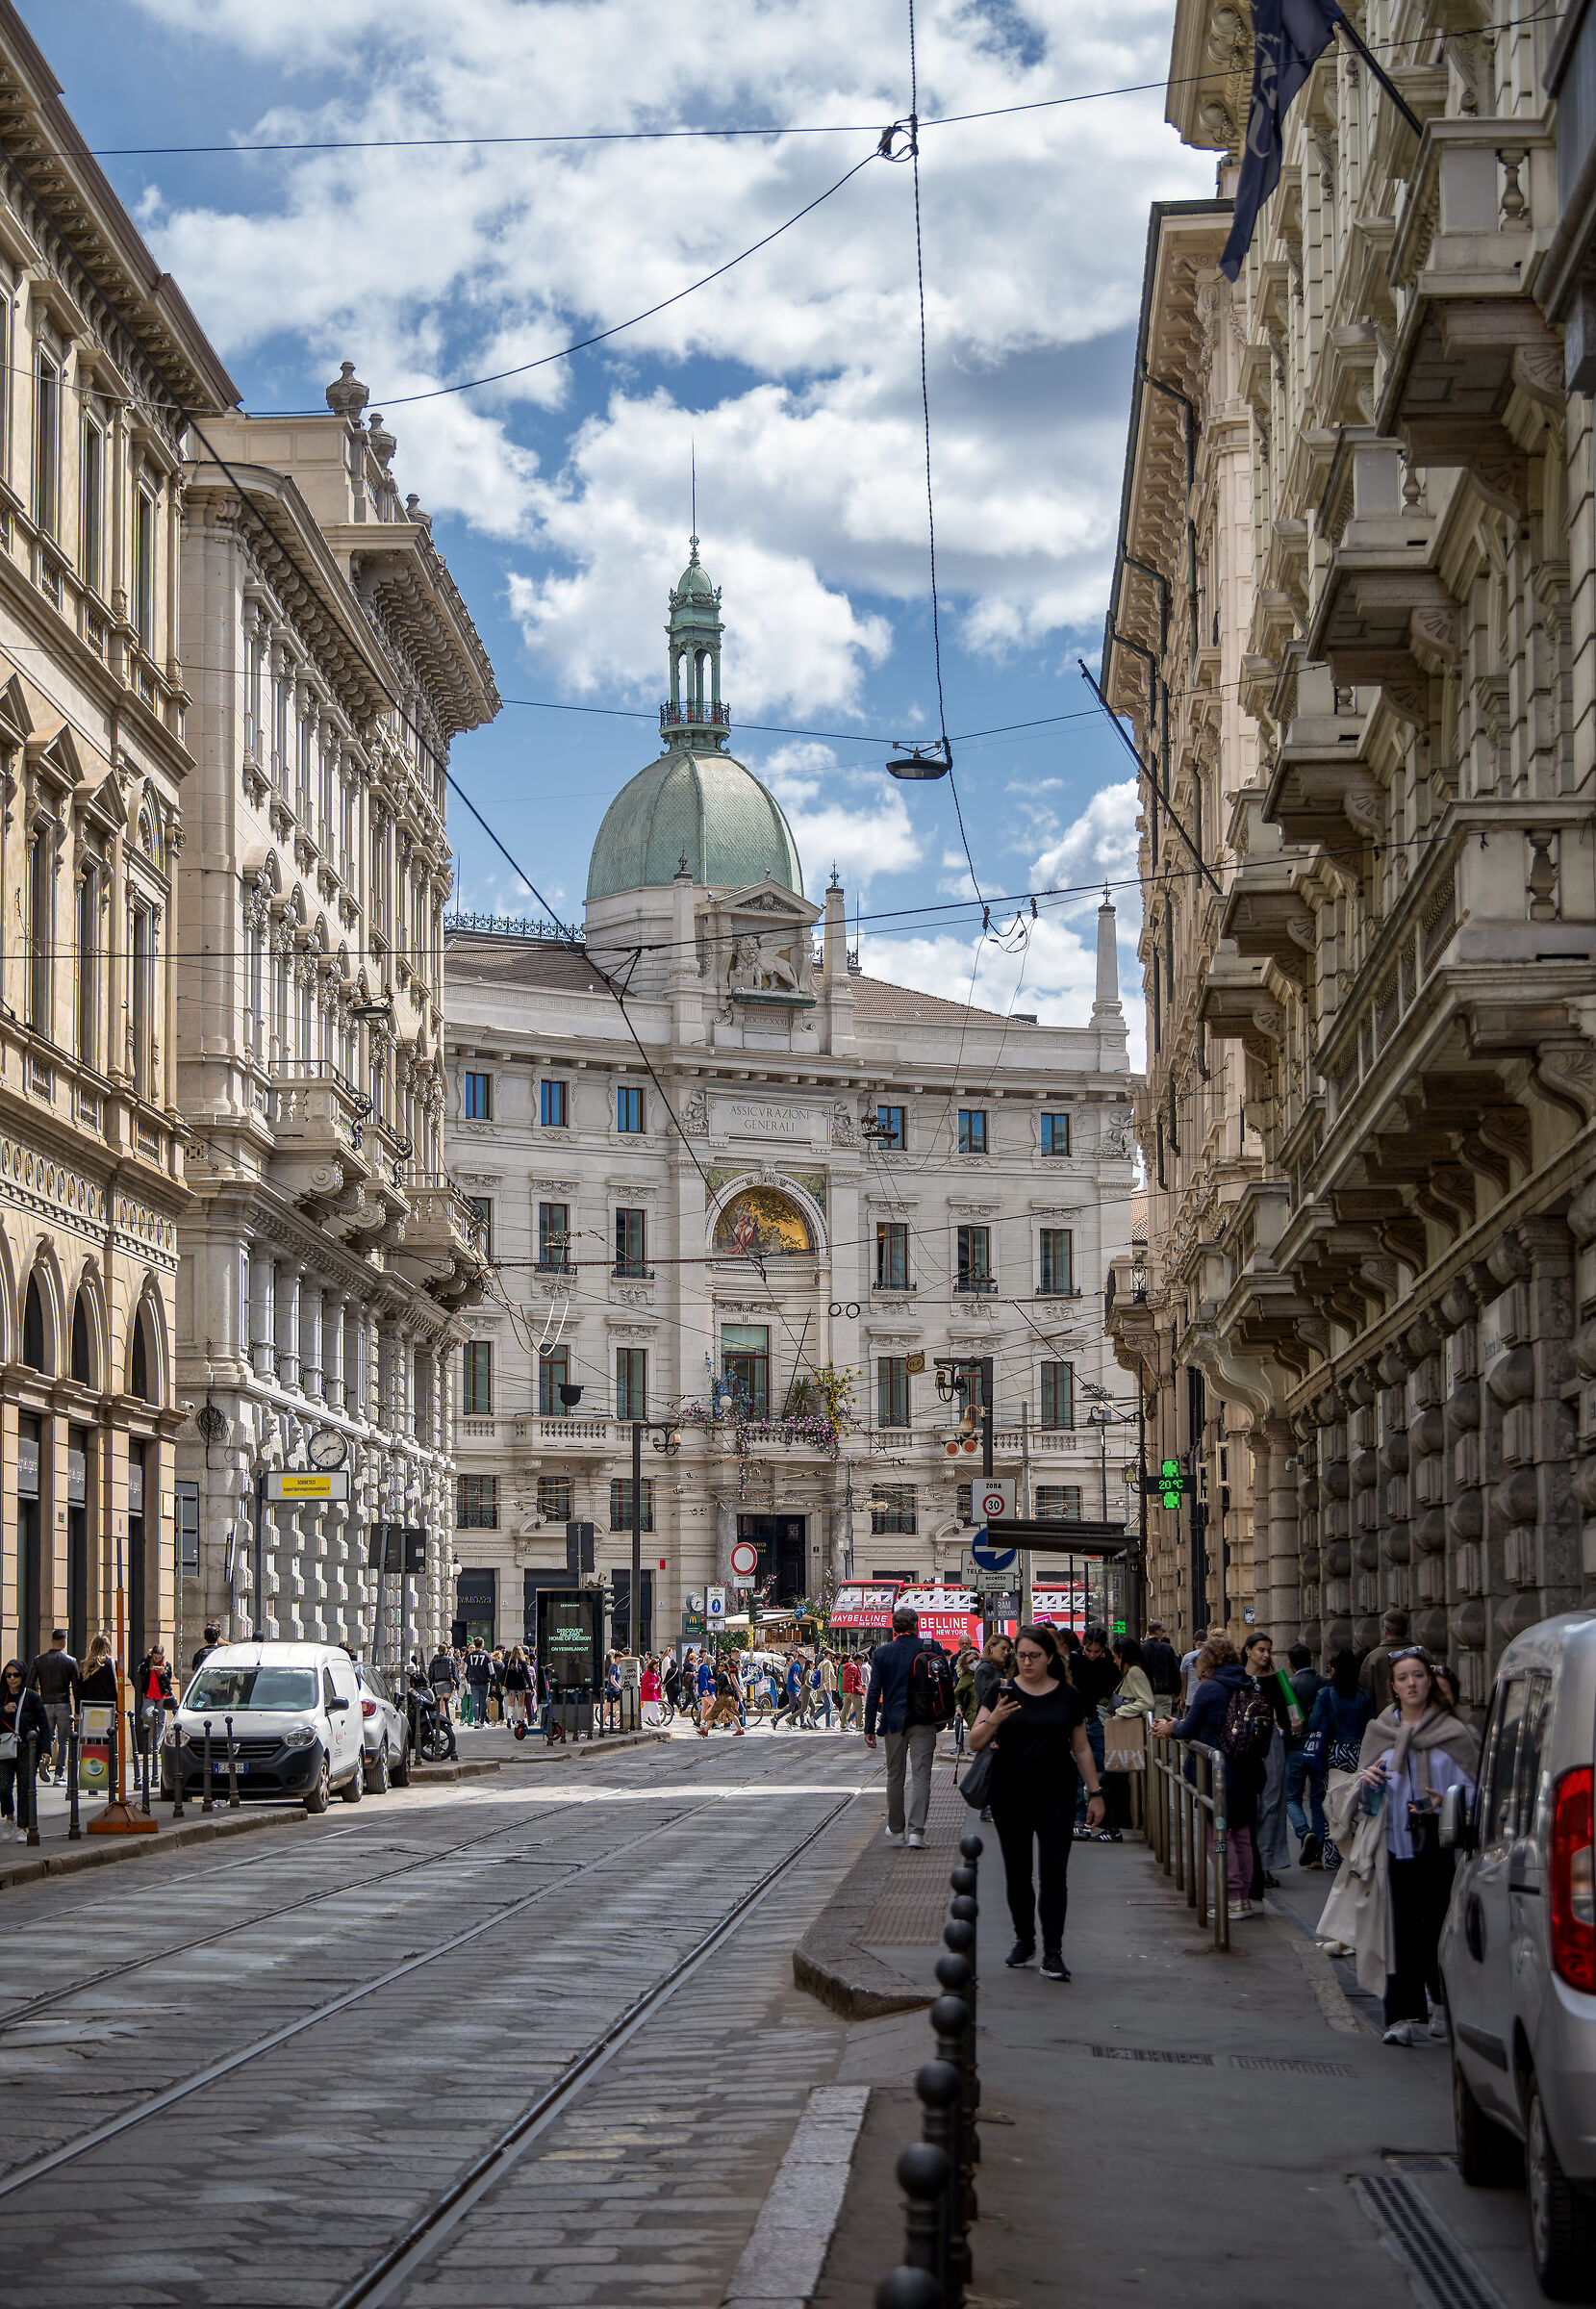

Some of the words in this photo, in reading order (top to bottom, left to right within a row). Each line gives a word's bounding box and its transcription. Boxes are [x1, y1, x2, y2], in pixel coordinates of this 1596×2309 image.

[730, 1105, 809, 1120] ASSICVRAZIONI
[744, 1119, 795, 1132] GENERALI
[1158, 1480, 1172, 1490] 20
[988, 1500, 1000, 1510] 30
[831, 1614, 888, 1623] MAYBELLINE
[920, 1617, 968, 1629] BELLINE
[469, 1655, 486, 1666] 177
[1105, 1749, 1145, 1769] ZARA
